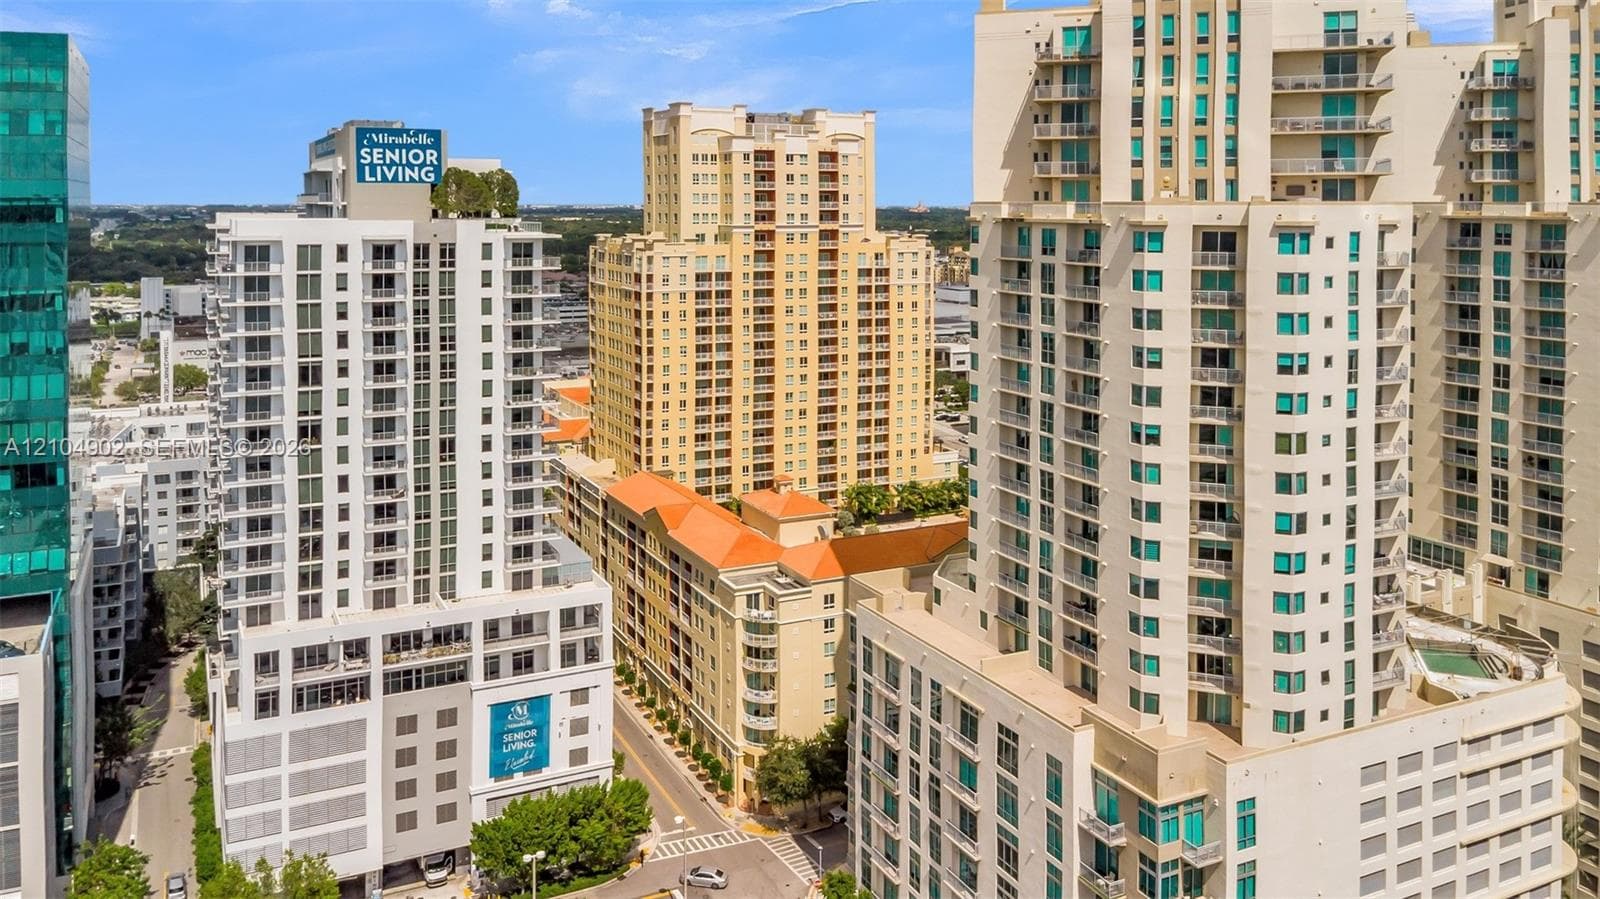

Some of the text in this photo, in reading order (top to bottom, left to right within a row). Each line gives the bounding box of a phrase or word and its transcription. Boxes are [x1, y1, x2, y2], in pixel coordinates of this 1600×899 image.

[363, 129, 434, 145] Mirabelle
[360, 148, 438, 164] SENIOR
[365, 166, 435, 182] LIVING
[503, 729, 537, 742] SENIOR
